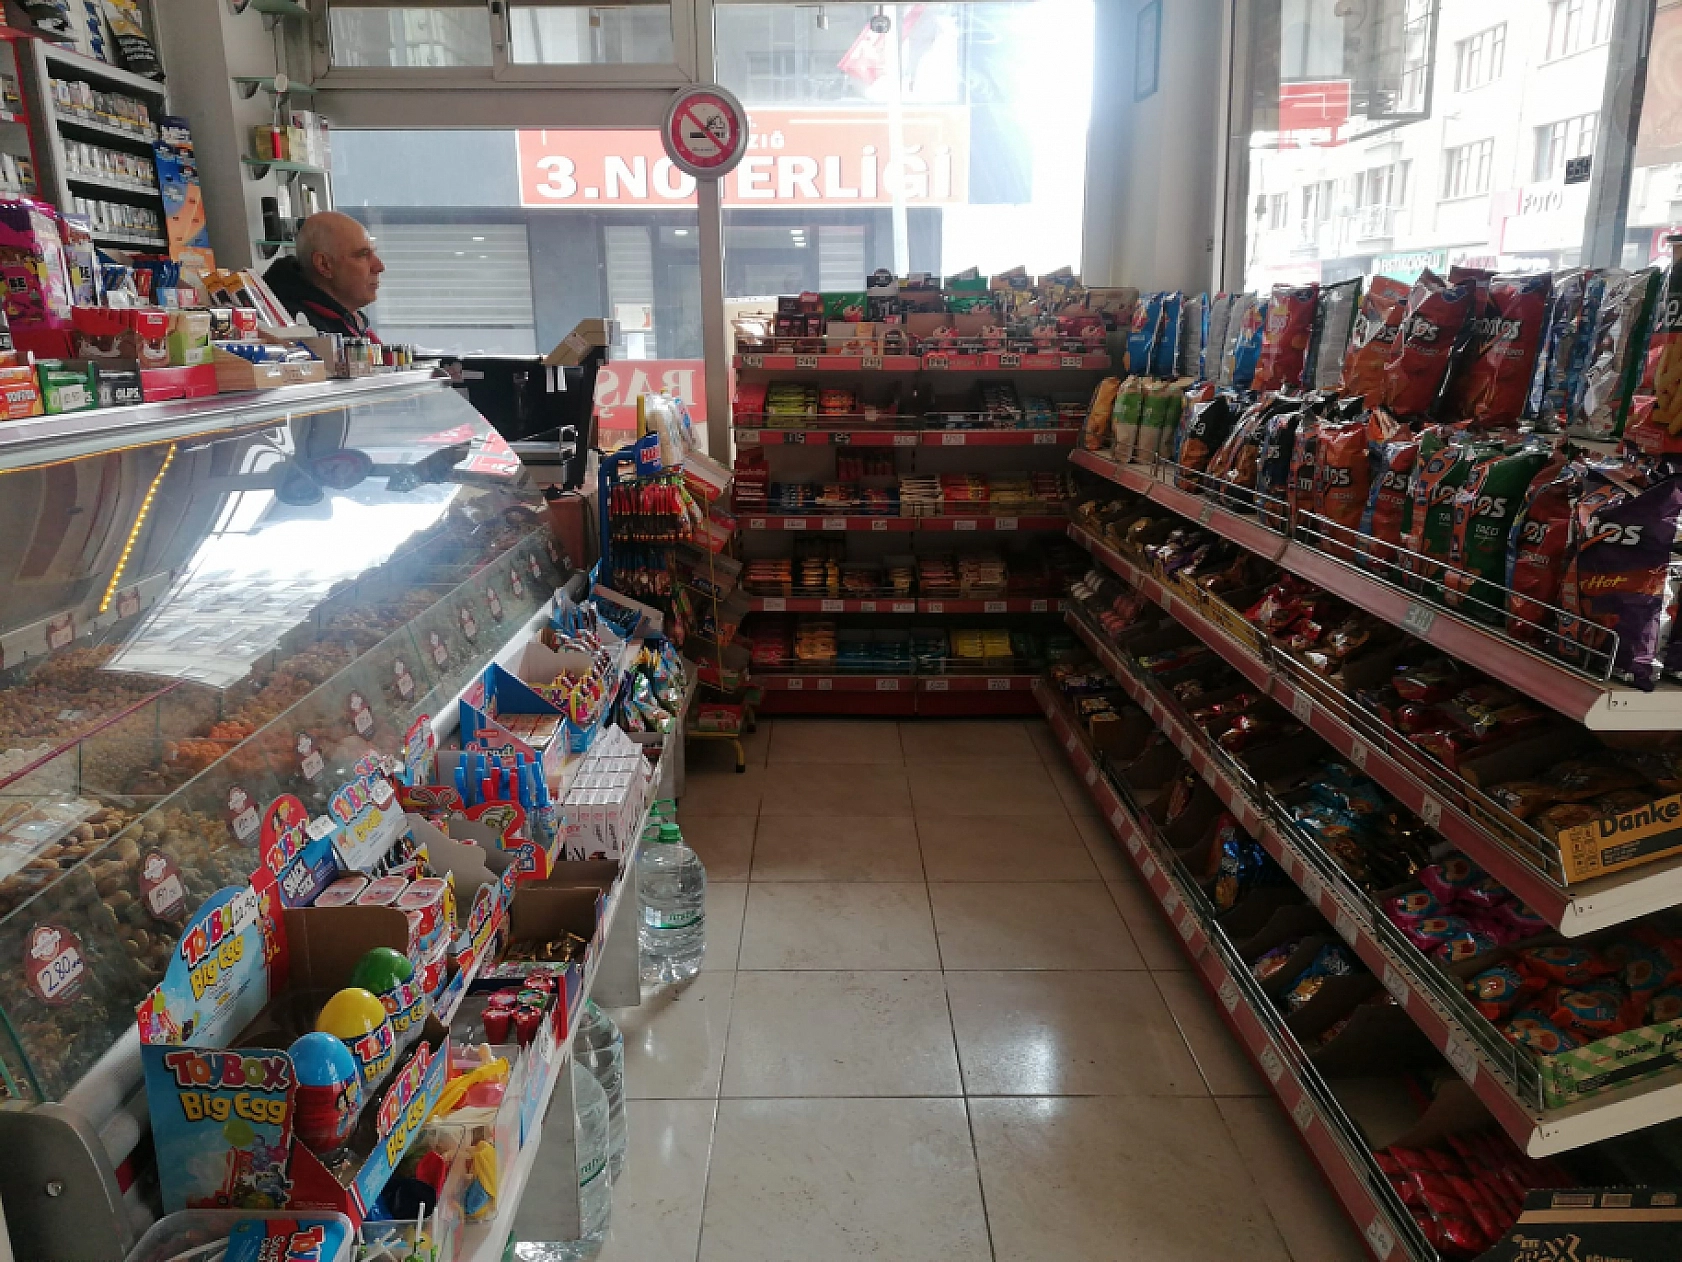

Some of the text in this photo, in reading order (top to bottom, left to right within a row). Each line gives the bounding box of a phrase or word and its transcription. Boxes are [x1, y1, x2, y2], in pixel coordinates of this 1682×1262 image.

[535, 143, 953, 200] 3.NOERLİĞİ
[180, 1092, 288, 1125] Big Egg
